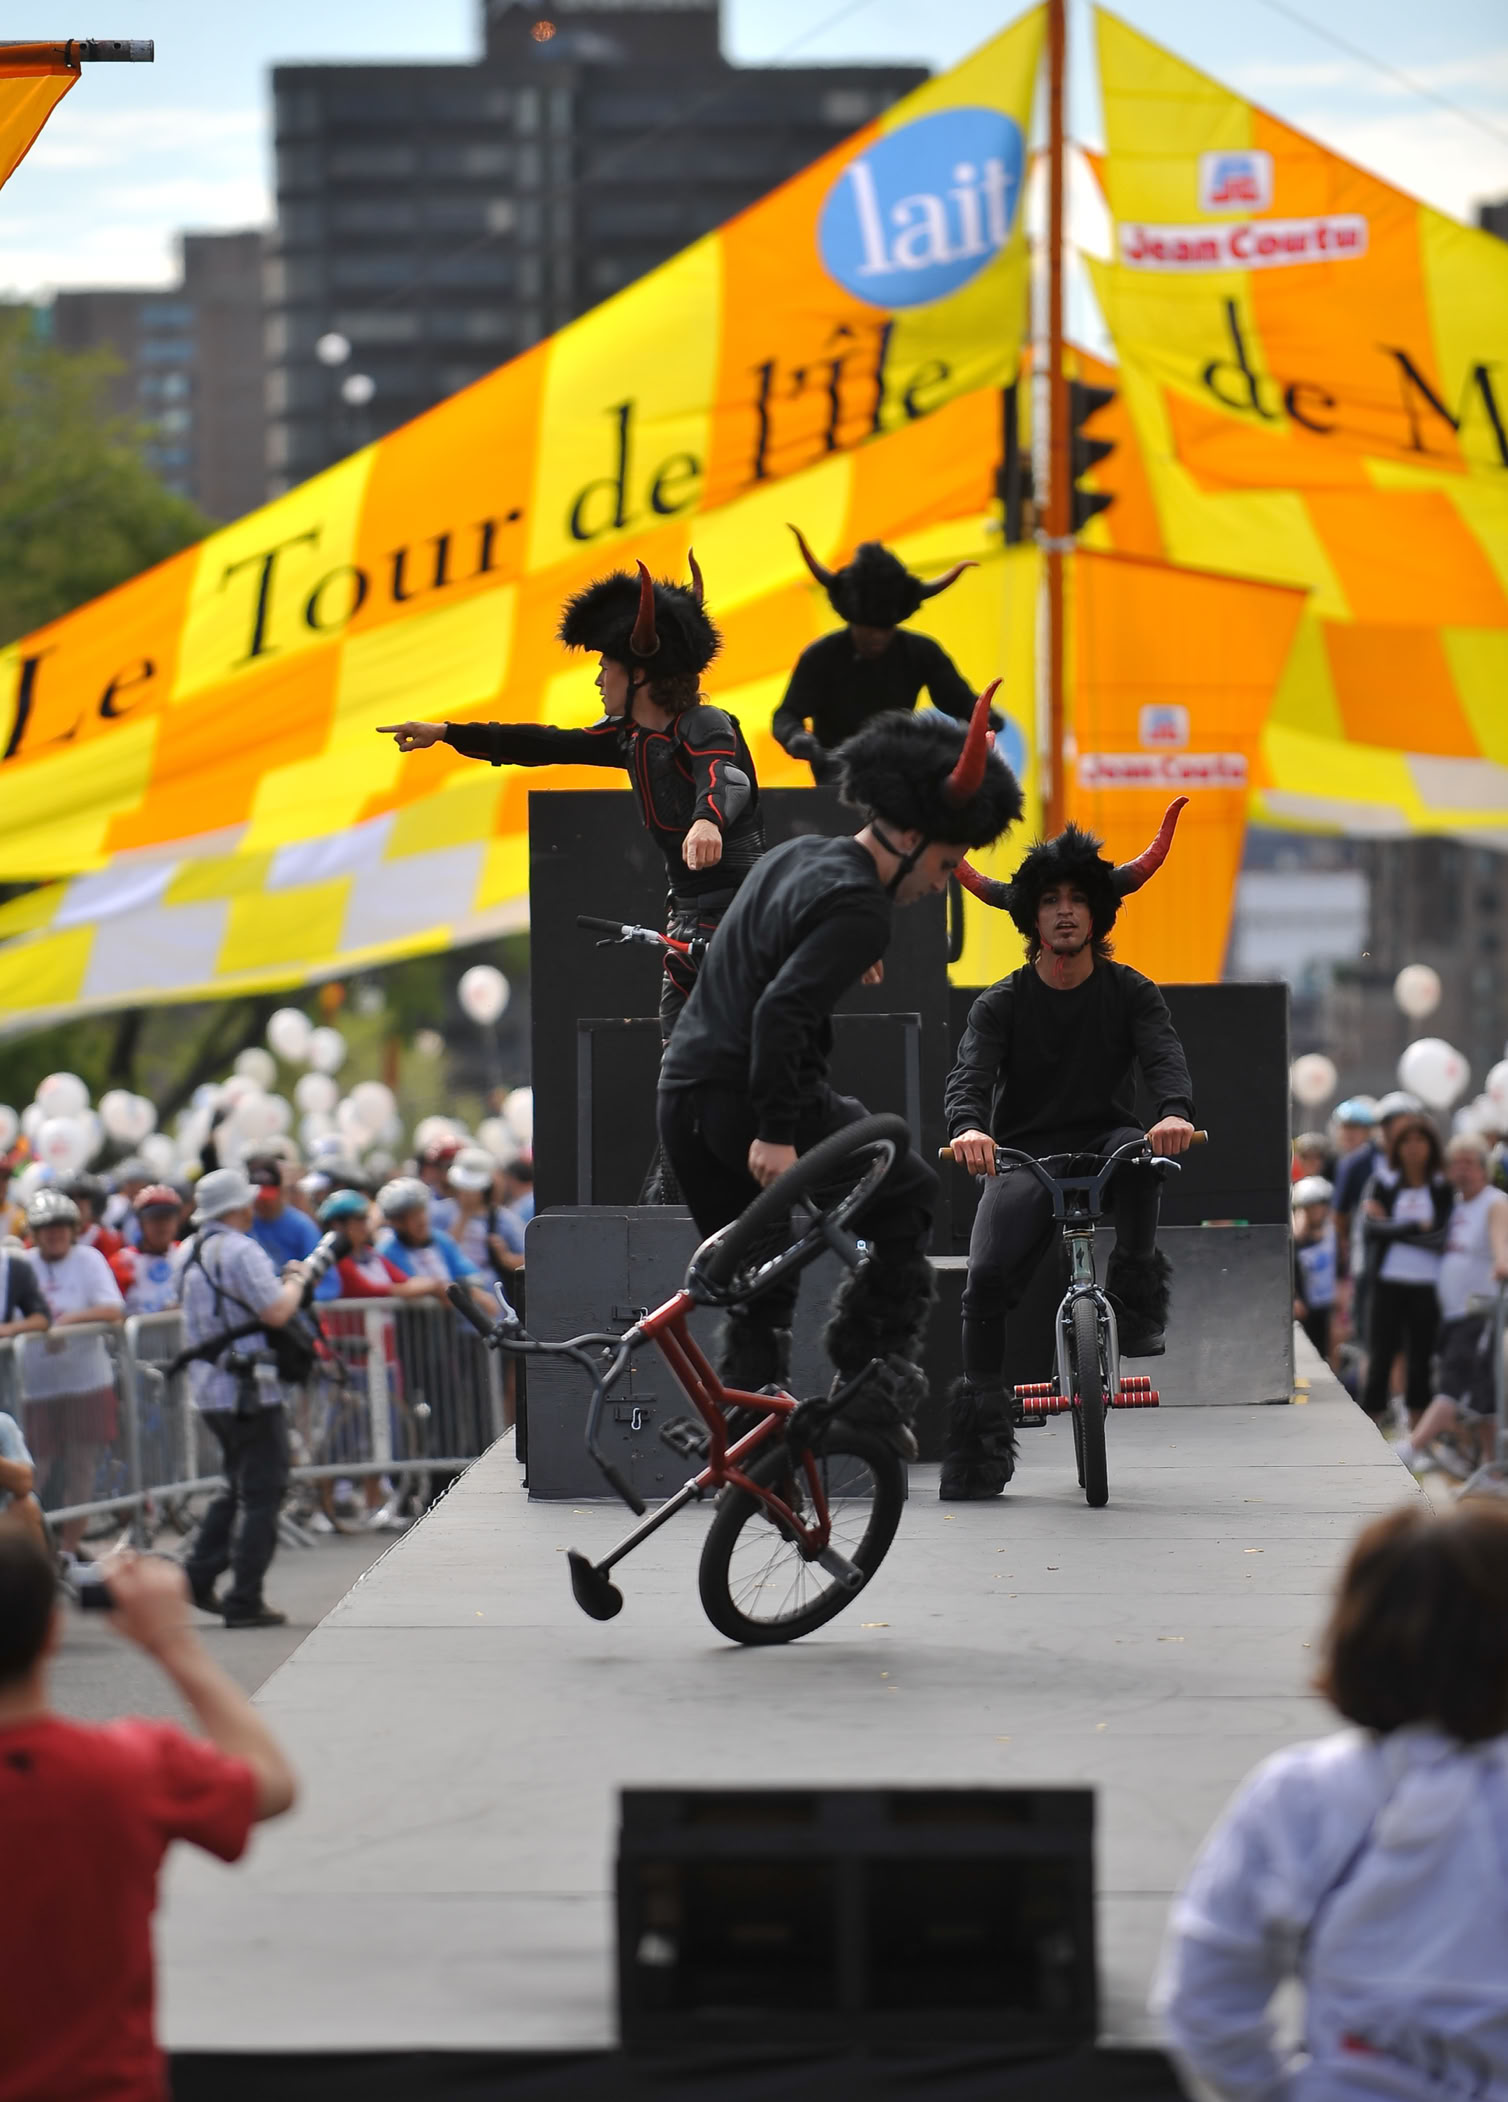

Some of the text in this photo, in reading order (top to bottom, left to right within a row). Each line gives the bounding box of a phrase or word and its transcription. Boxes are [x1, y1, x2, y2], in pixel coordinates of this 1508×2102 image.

[847, 155, 1014, 277] lait
[1122, 221, 1358, 263] Jean Coutu
[1202, 297, 1336, 435] de
[2, 645, 156, 761] Le
[218, 507, 524, 667] Tour
[569, 398, 704, 542] de
